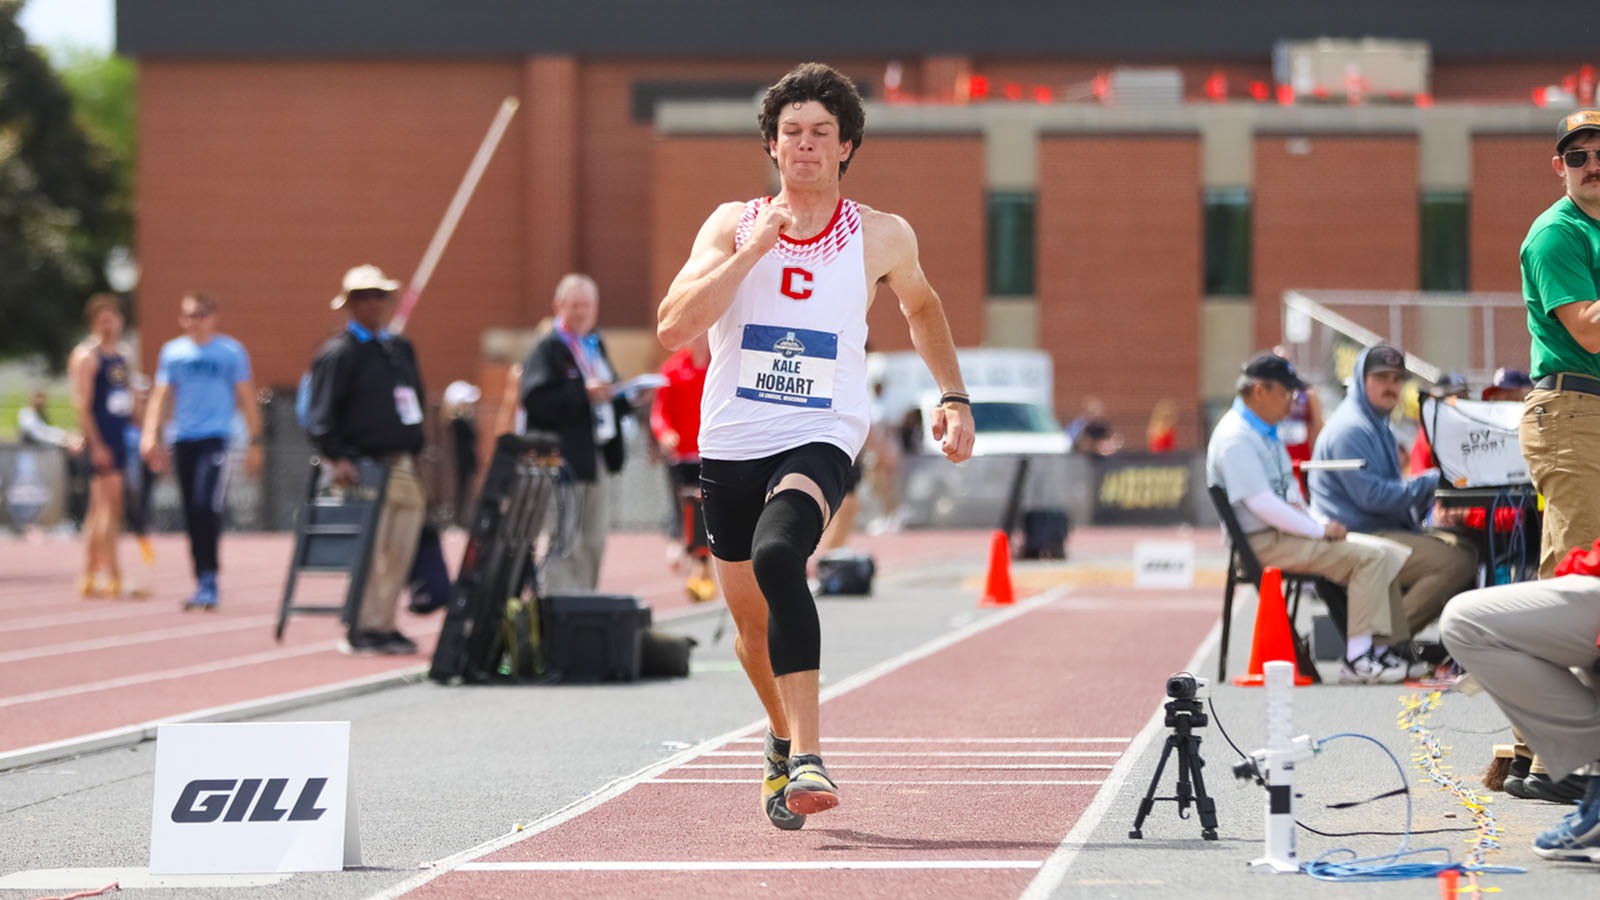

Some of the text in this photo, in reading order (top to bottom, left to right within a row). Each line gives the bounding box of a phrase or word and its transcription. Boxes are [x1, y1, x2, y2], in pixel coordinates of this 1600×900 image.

[781, 267, 814, 300] C
[772, 358, 802, 374] KALE
[755, 372, 815, 395] HOBART
[1469, 430, 1491, 444] DV
[1461, 440, 1505, 456] SPORT
[171, 777, 328, 823] GILL
